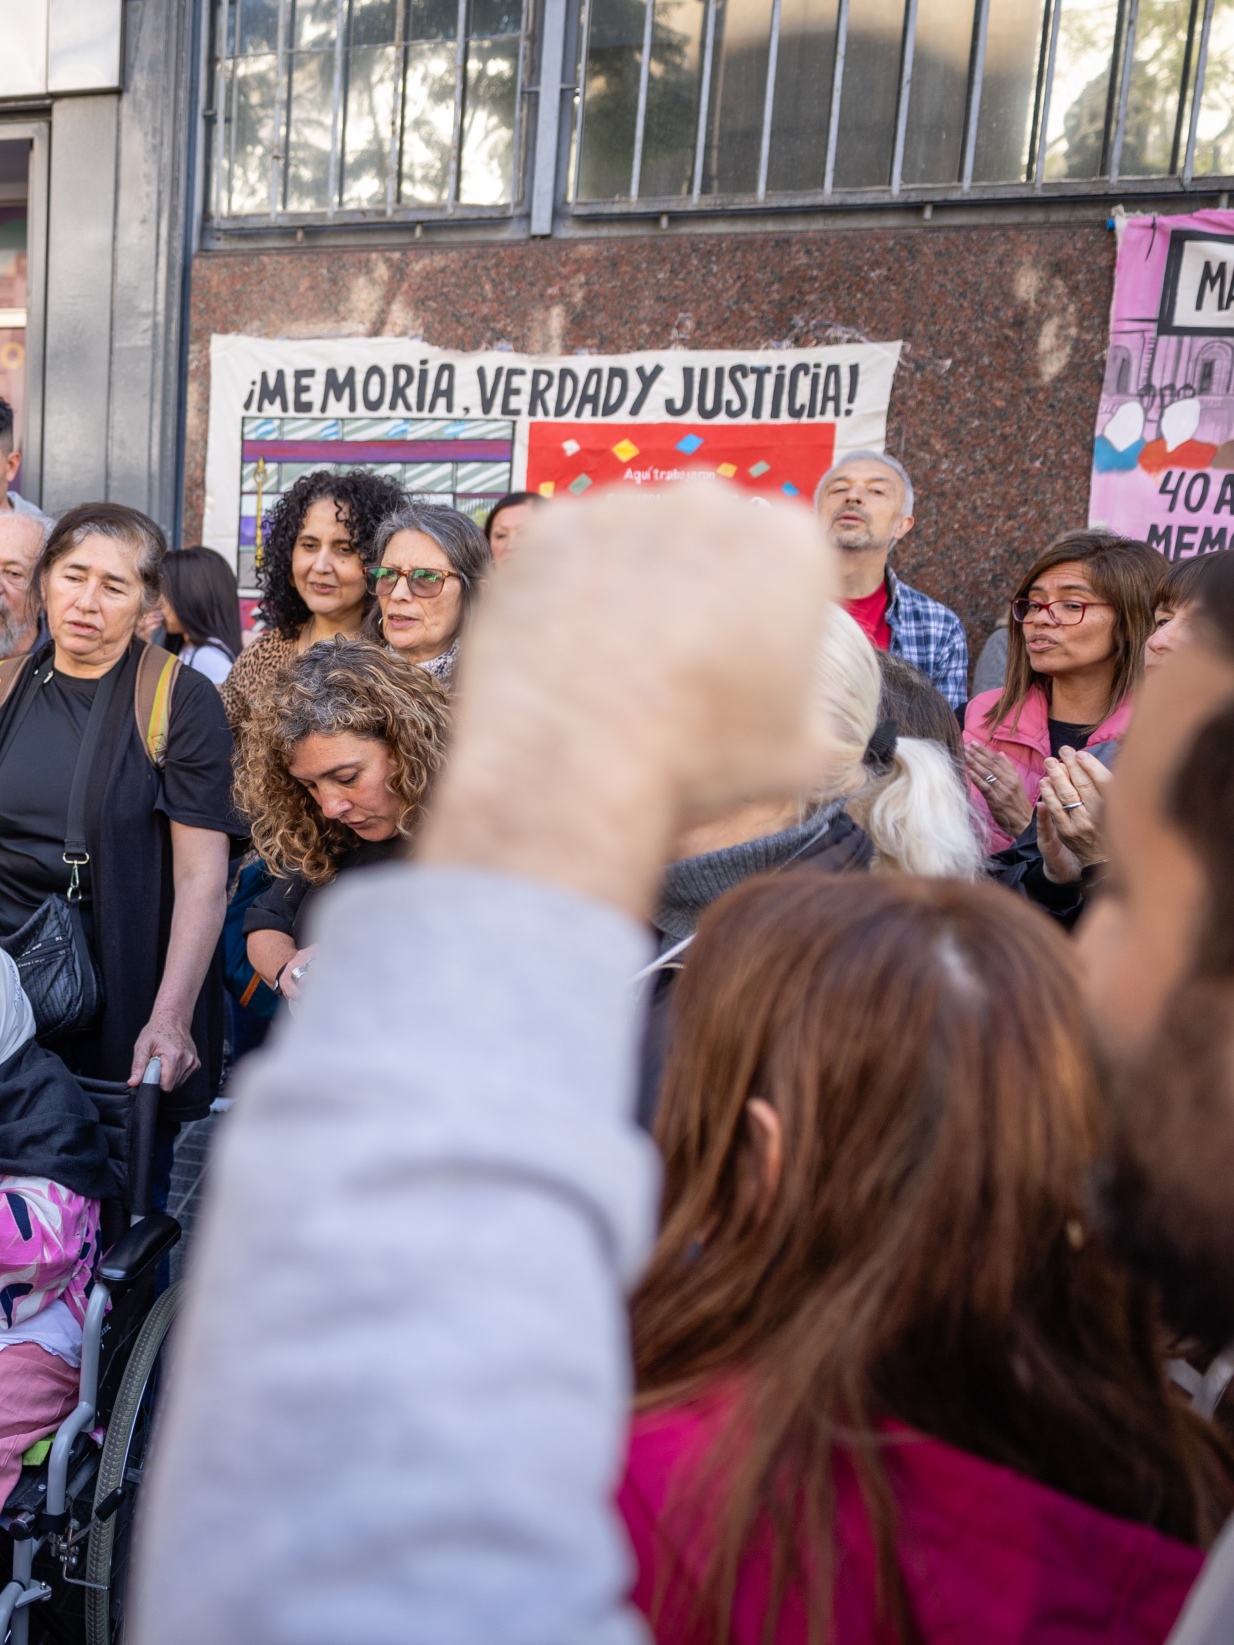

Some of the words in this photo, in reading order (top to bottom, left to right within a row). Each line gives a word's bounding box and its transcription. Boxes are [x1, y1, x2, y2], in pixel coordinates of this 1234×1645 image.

[477, 366, 628, 416] VERDAD
[629, 363, 664, 417] Y
[1159, 470, 1211, 514] 40
[1147, 524, 1234, 563] MEM
